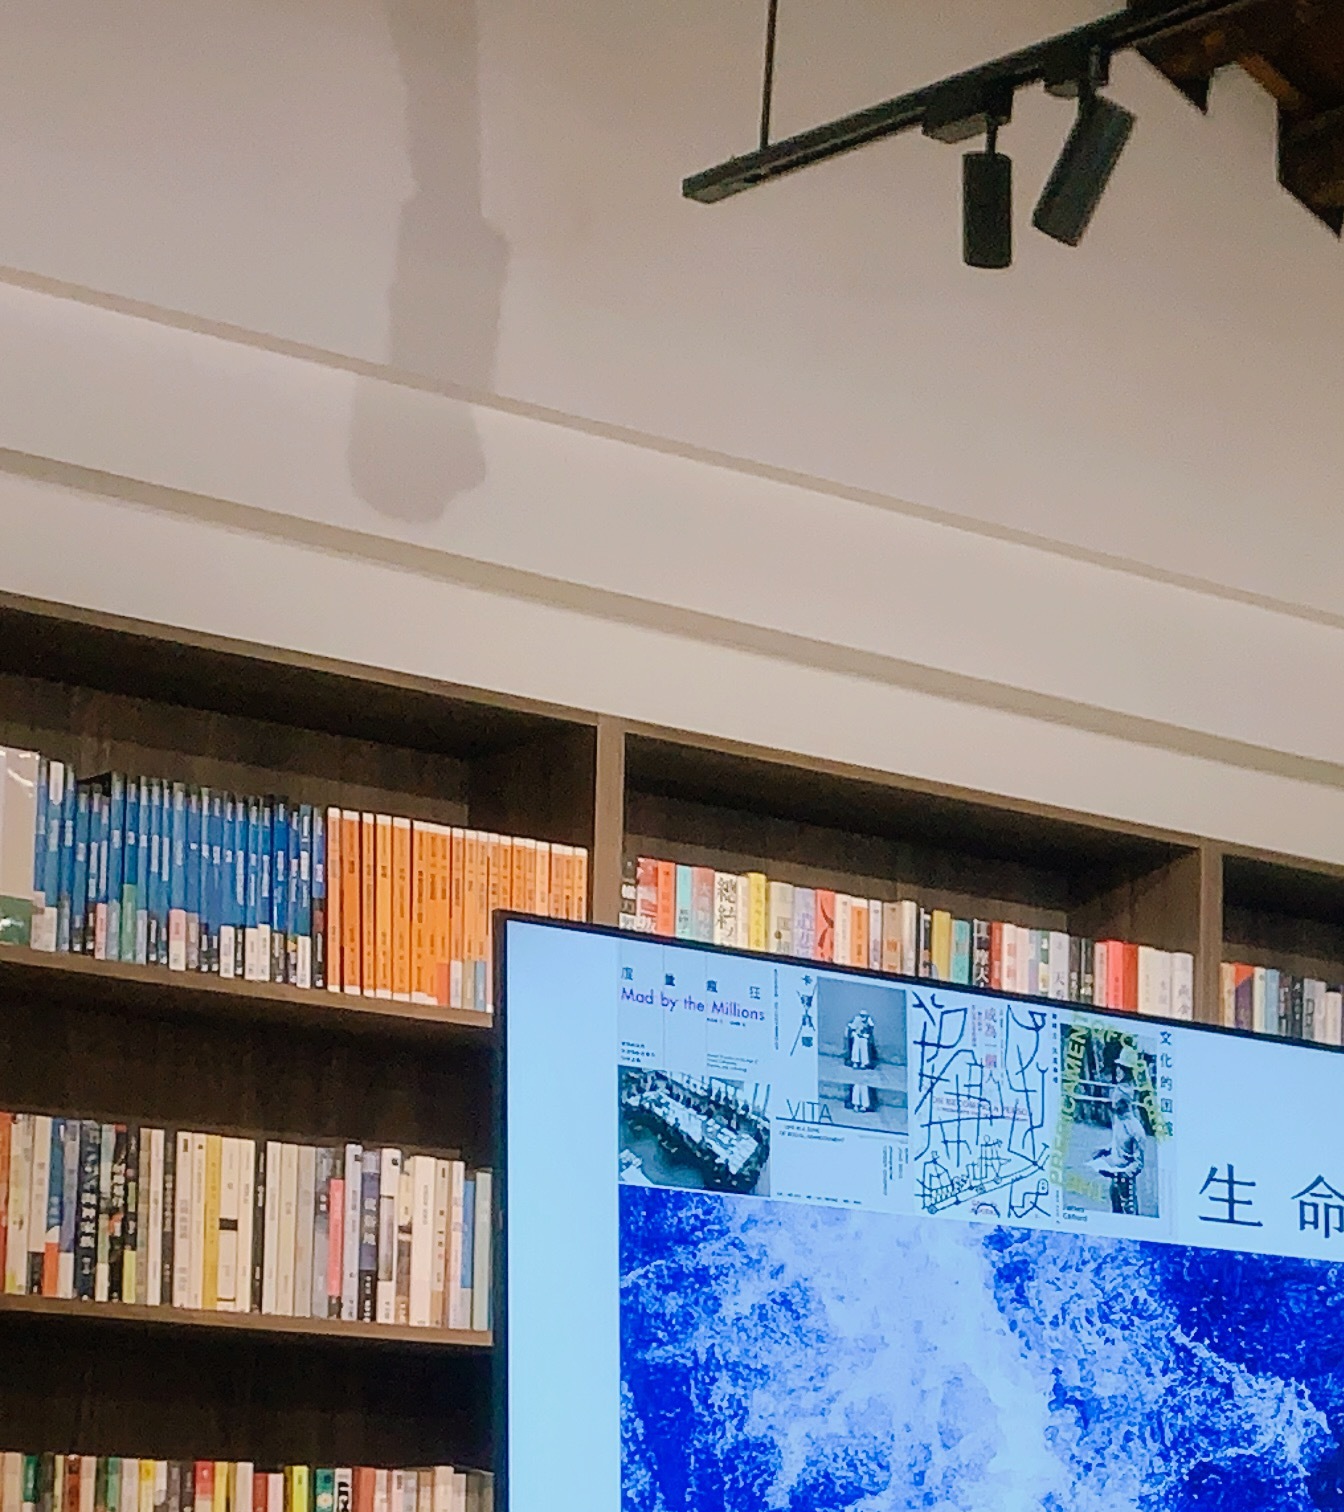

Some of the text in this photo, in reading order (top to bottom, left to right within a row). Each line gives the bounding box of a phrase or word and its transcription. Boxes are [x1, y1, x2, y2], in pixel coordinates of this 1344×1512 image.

[620, 987, 654, 1006] Mad
[660, 990, 677, 1012] by
[684, 993, 705, 1011] the
[712, 1001, 765, 1022] Millions
[786, 1098, 833, 1124] VITA
